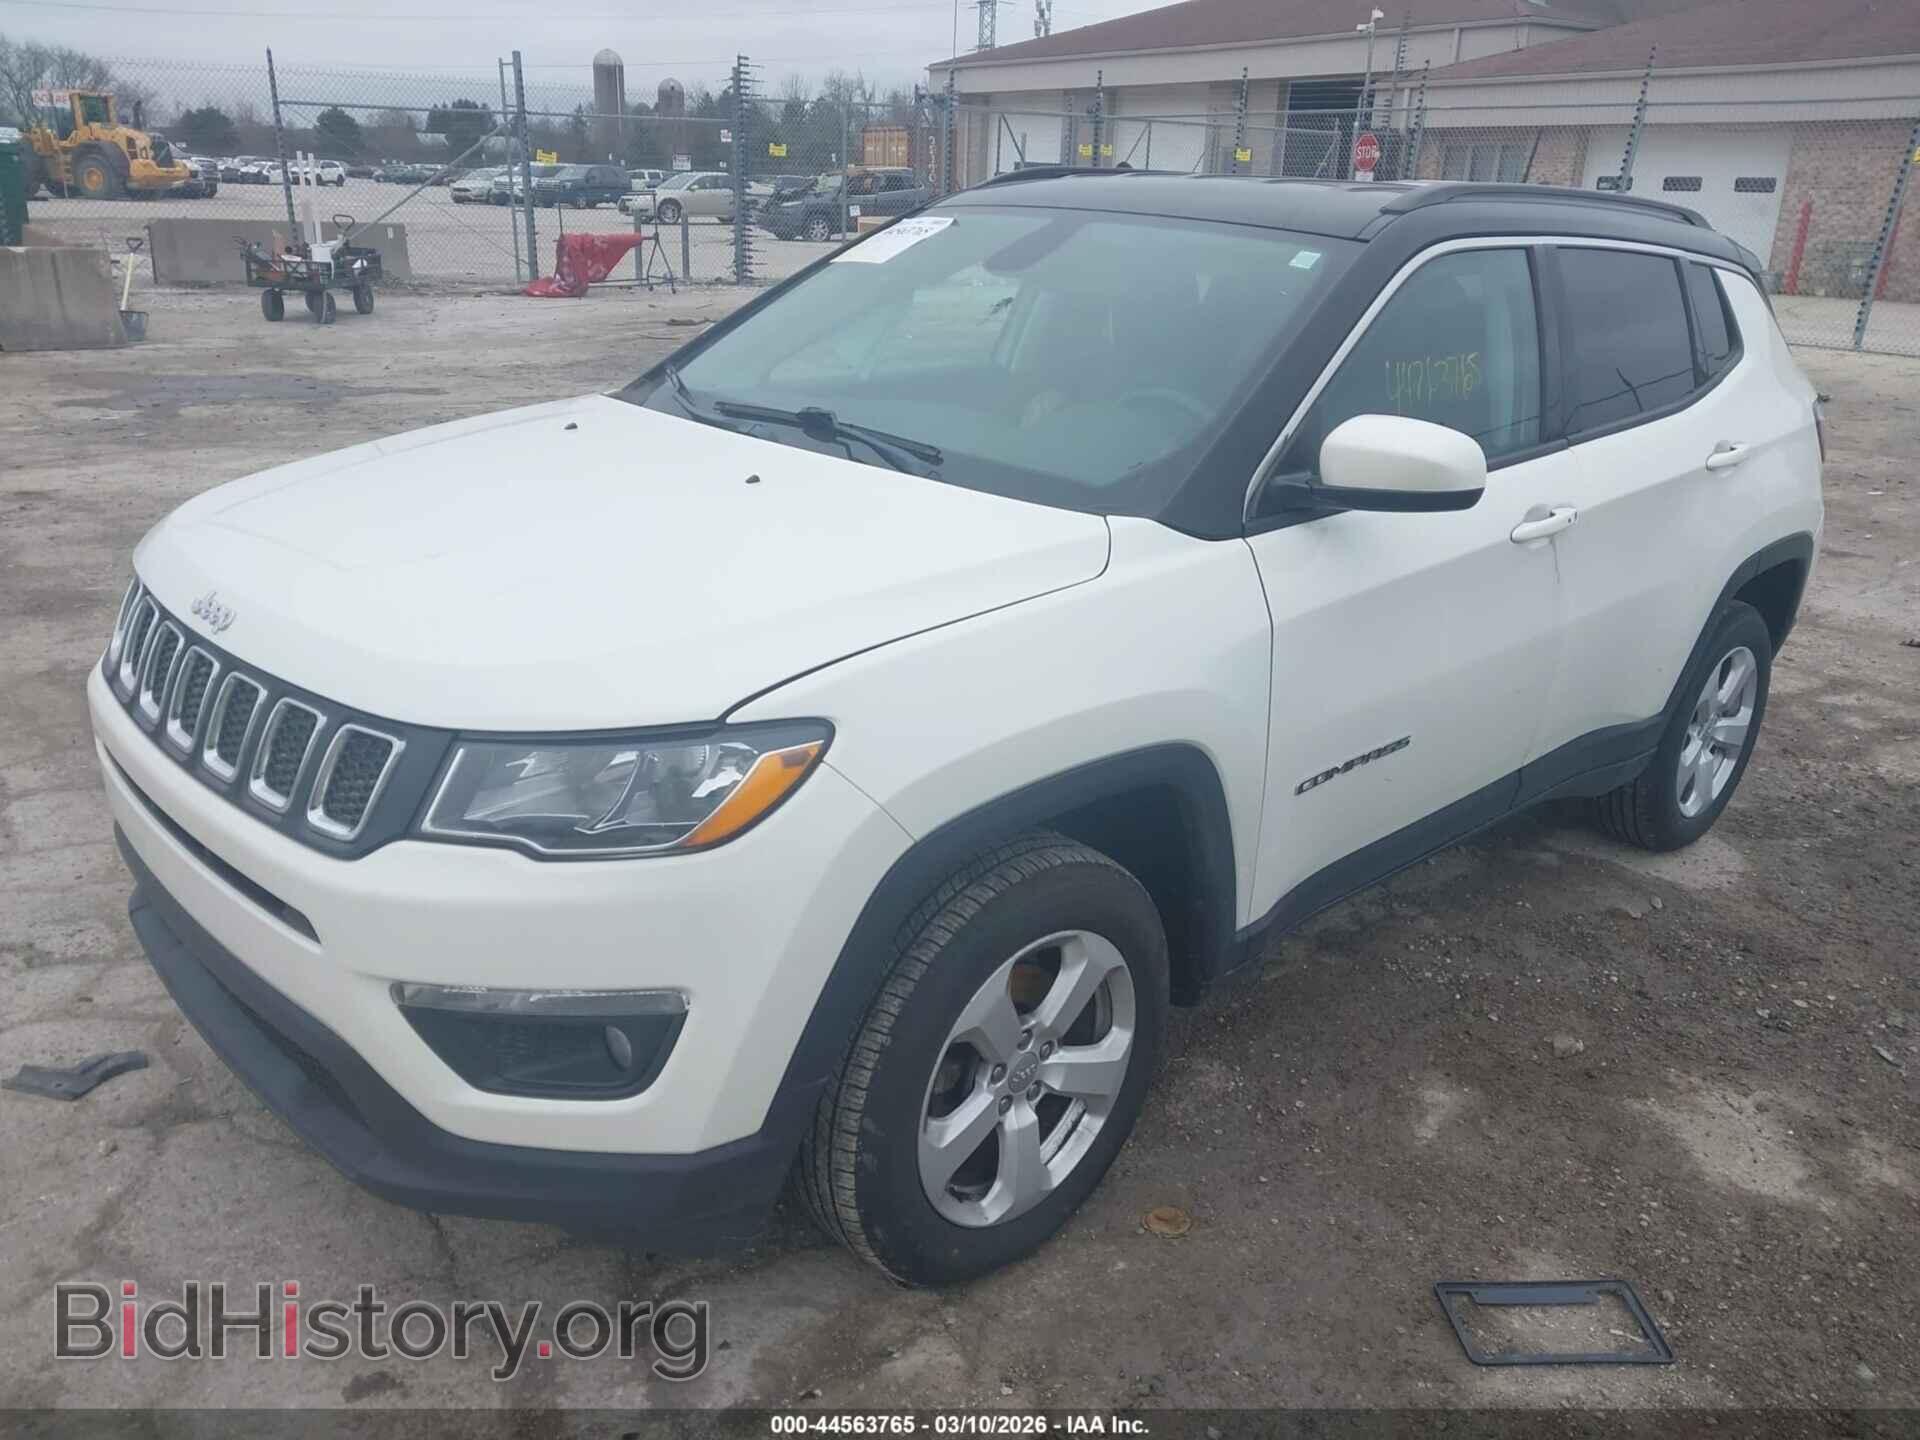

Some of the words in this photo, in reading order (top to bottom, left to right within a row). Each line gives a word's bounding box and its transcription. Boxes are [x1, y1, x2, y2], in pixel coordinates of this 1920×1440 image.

[1356, 144, 1378, 160] STOP
[192, 592, 237, 635] Jeep
[1295, 736, 1411, 795] COMPASS
